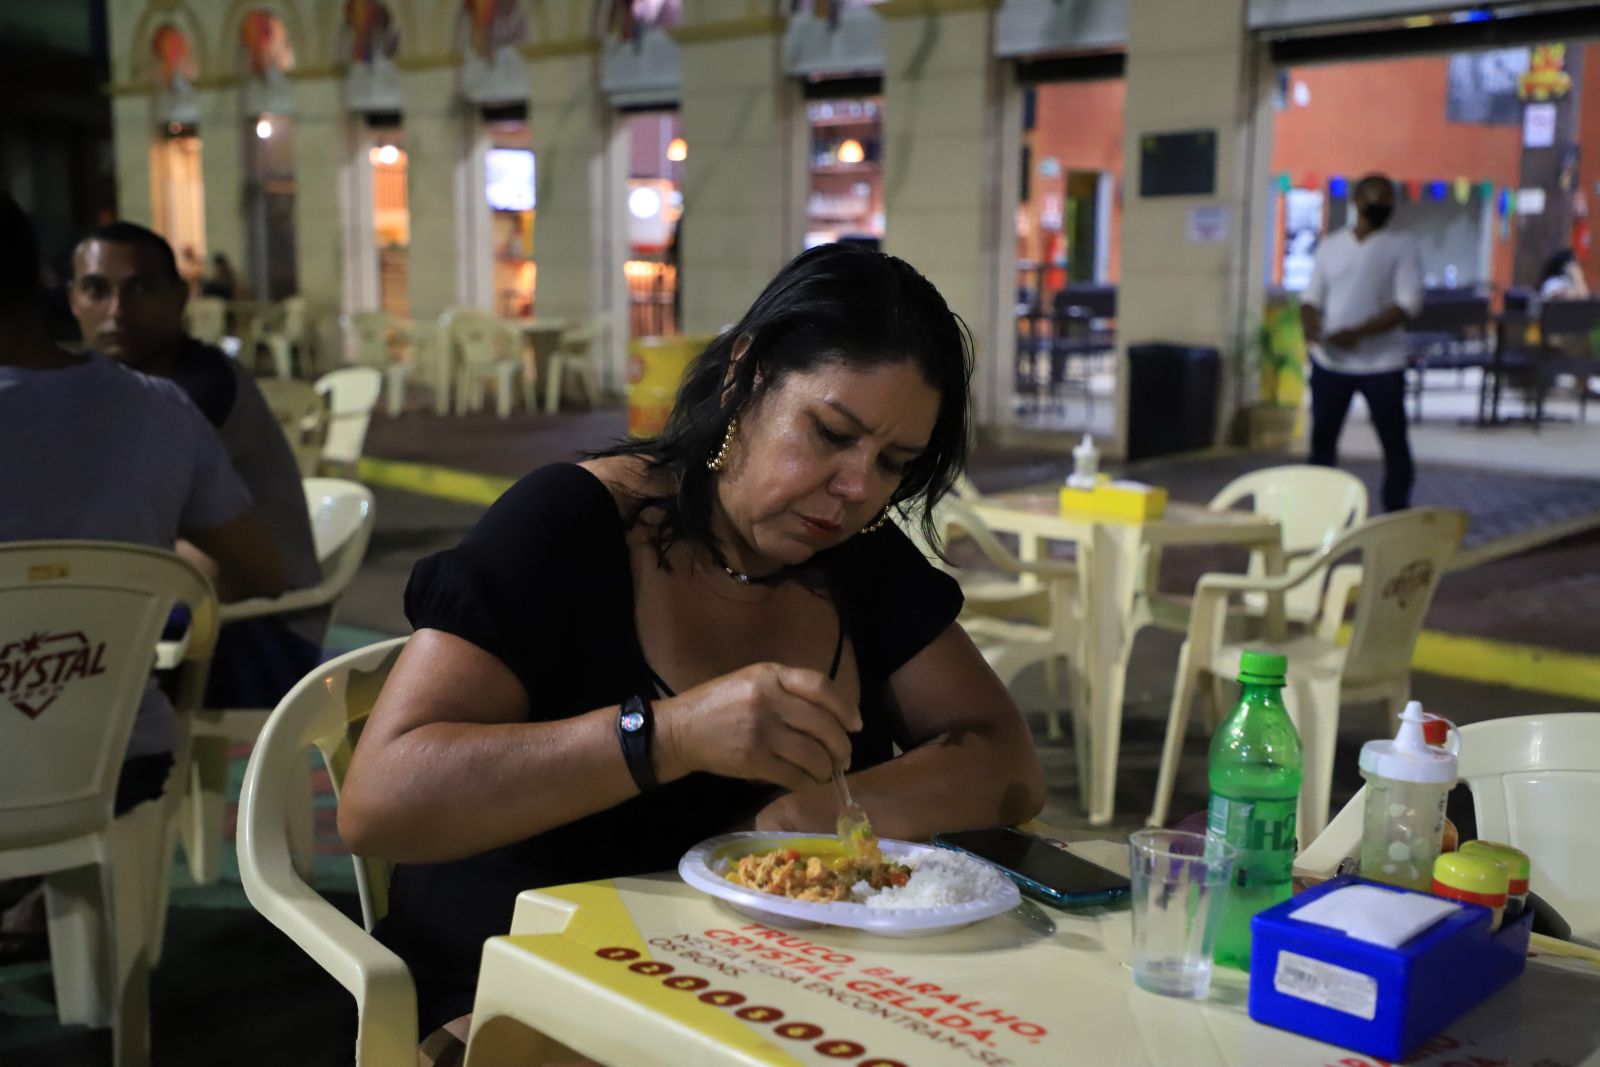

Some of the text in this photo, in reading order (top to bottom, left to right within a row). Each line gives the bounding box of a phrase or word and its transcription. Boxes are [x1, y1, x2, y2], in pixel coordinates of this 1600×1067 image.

[648, 937, 740, 979] OS BONS.
[703, 929, 998, 1048] CRYSTAL GELADA.
[860, 966, 1048, 1045] BARALHO,
